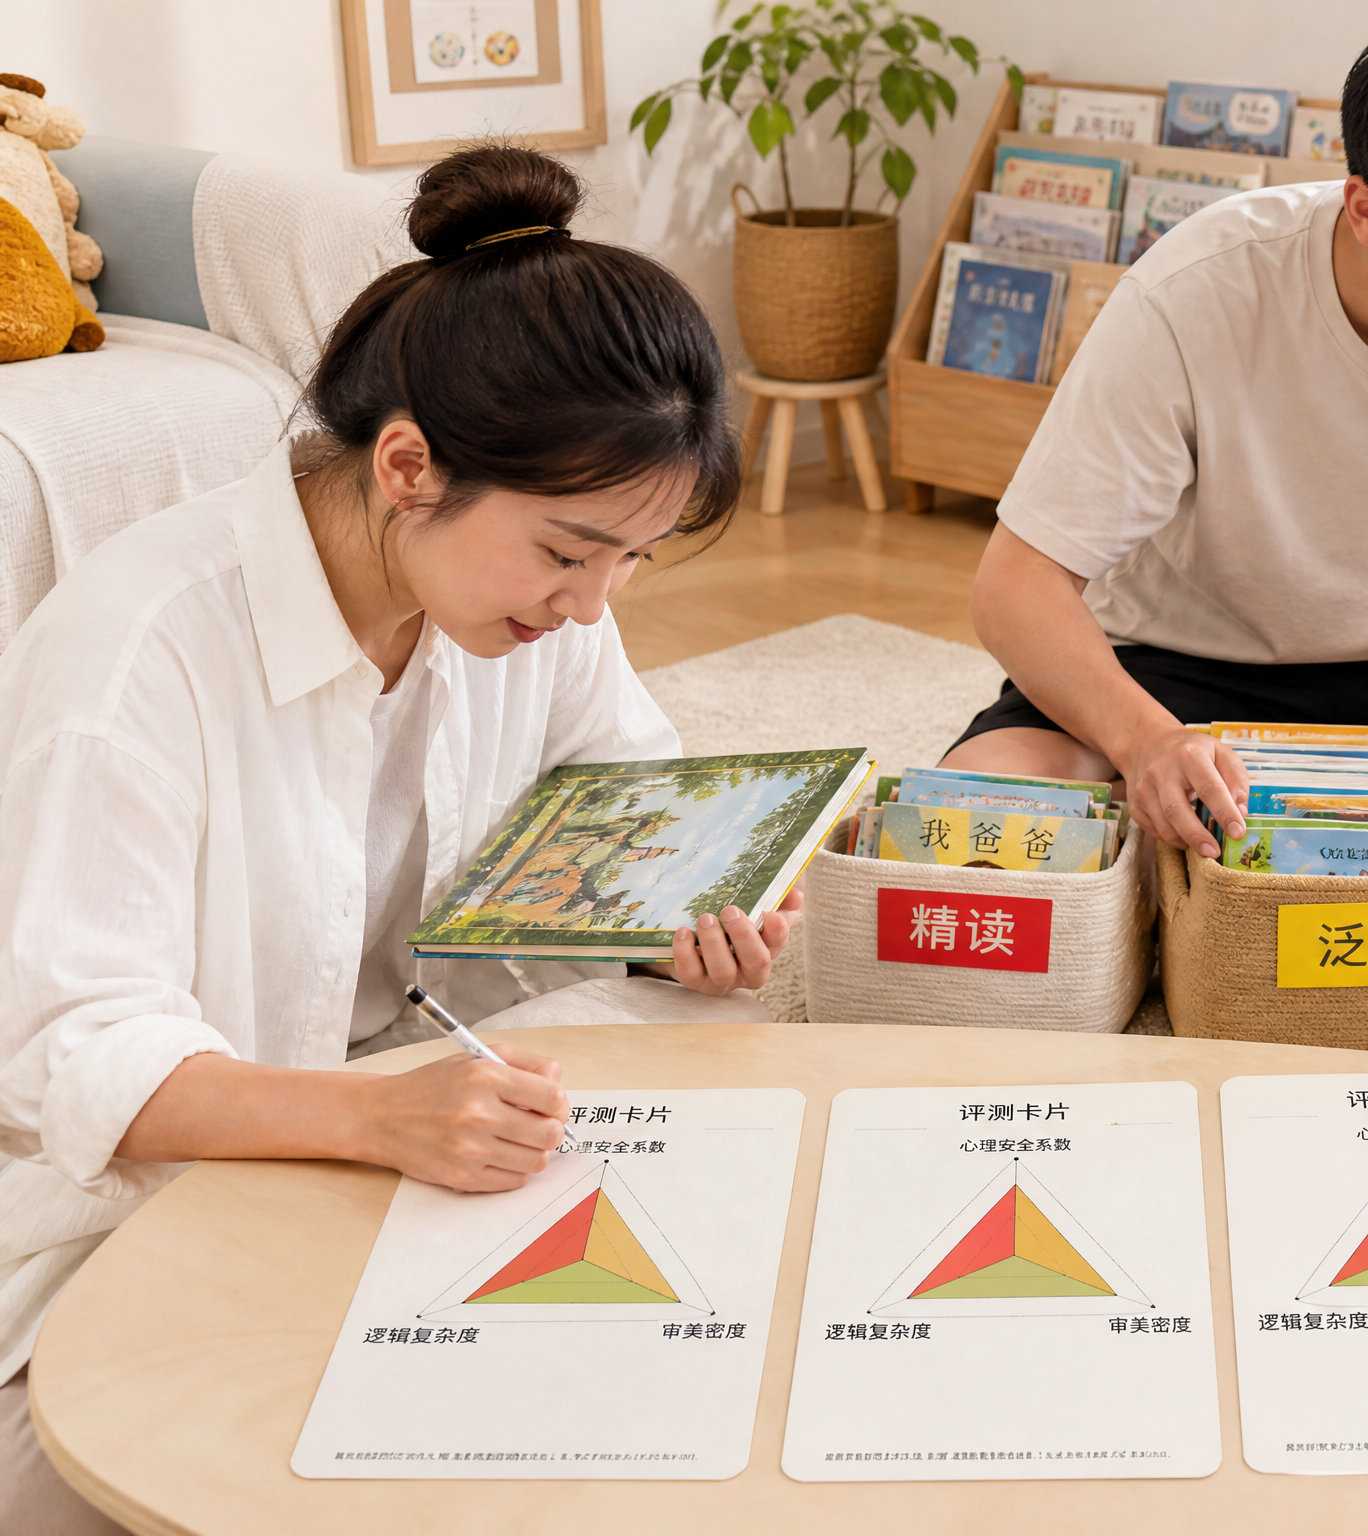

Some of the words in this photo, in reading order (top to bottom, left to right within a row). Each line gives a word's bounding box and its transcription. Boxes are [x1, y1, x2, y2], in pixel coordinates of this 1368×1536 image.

[919, 818, 1054, 861] 我爸爸
[909, 902, 1015, 957] 精读
[959, 1102, 1070, 1122] 评测卡片
[556, 1140, 667, 1154] 心理安全系数
[959, 1137, 1071, 1153] 心理安全系数
[661, 1322, 747, 1341] 审美密度
[824, 1322, 932, 1341] 逻辑复杂度
[1108, 1316, 1192, 1334] 审美密度
[363, 1326, 481, 1345] 逻辑复杂度
